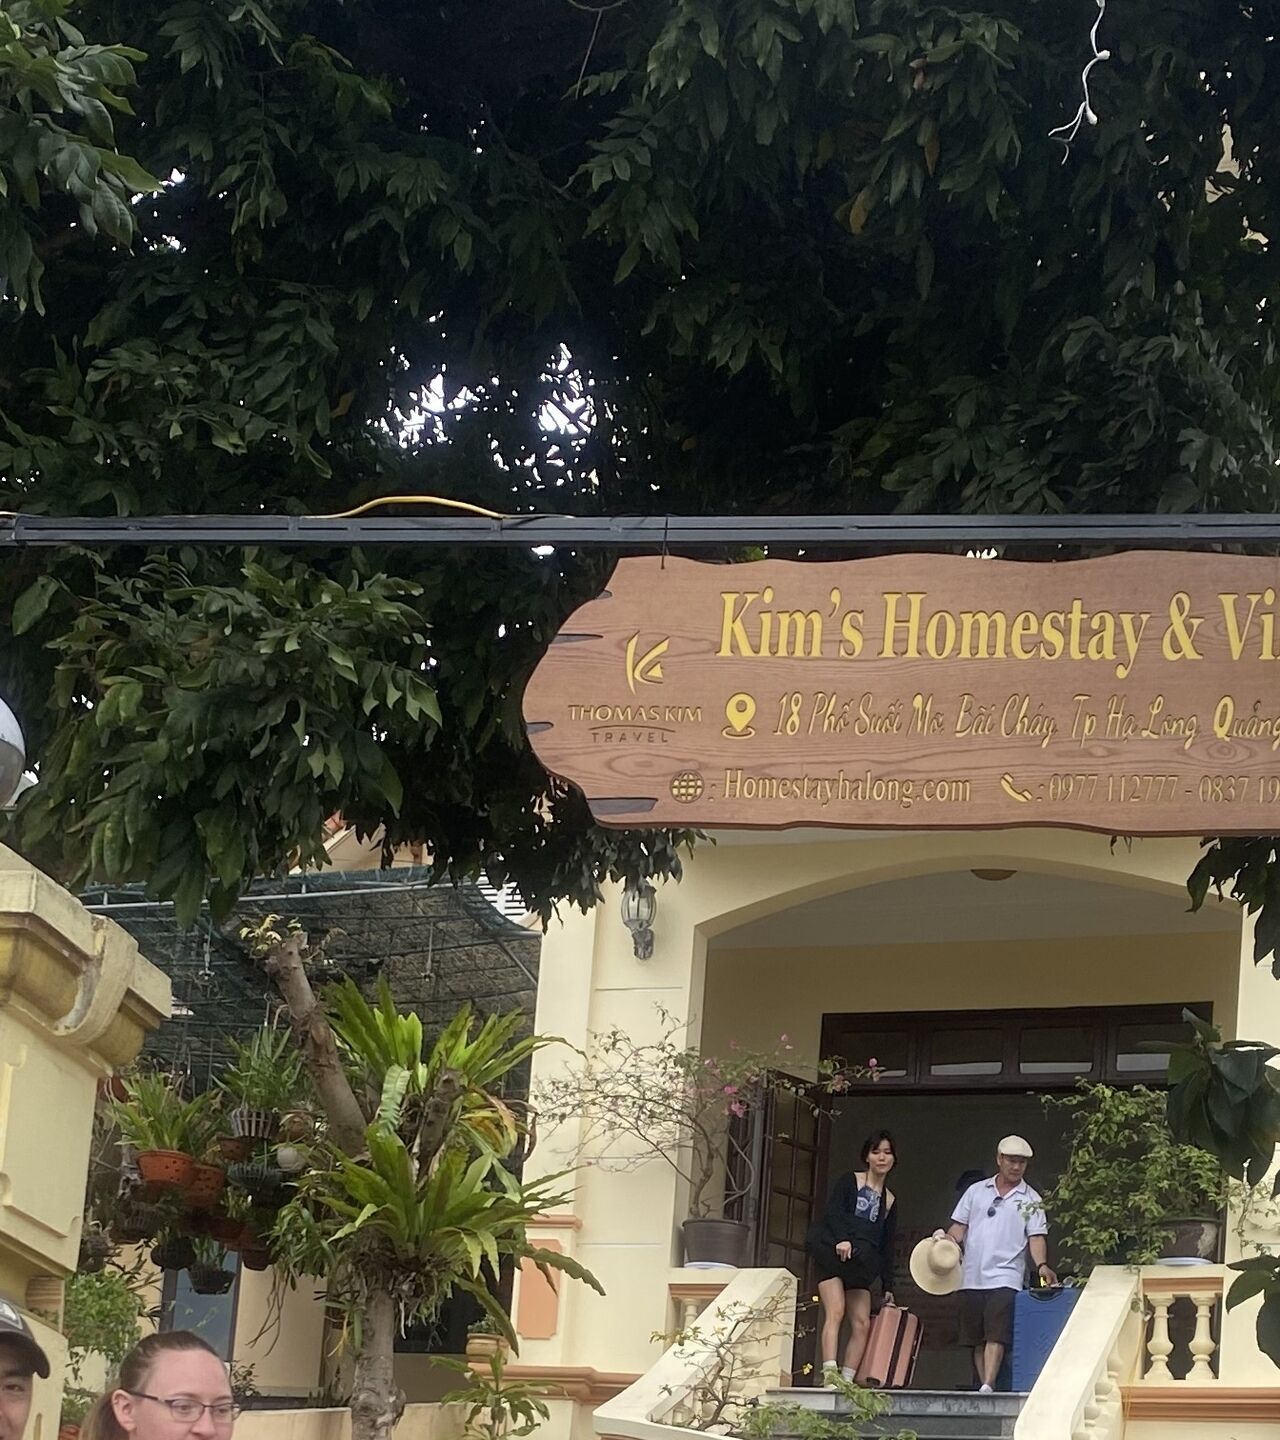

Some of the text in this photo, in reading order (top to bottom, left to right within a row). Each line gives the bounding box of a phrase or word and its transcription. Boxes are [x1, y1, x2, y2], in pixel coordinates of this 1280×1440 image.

[716, 585, 865, 659] Kim's
[877, 591, 1151, 680] Homestay
[1161, 591, 1205, 662] &
[567, 703, 703, 723] THOMAS KIM
[772, 691, 803, 737] 18
[807, 691, 854, 736] Phố
[854, 691, 904, 737] Suối
[954, 692, 997, 739] Bãi
[1104, 693, 1138, 745] Hạ
[591, 731, 669, 743] TRAVEL
[722, 767, 972, 809] Homestayhalong.com
[1048, 772, 1099, 802] 0977
